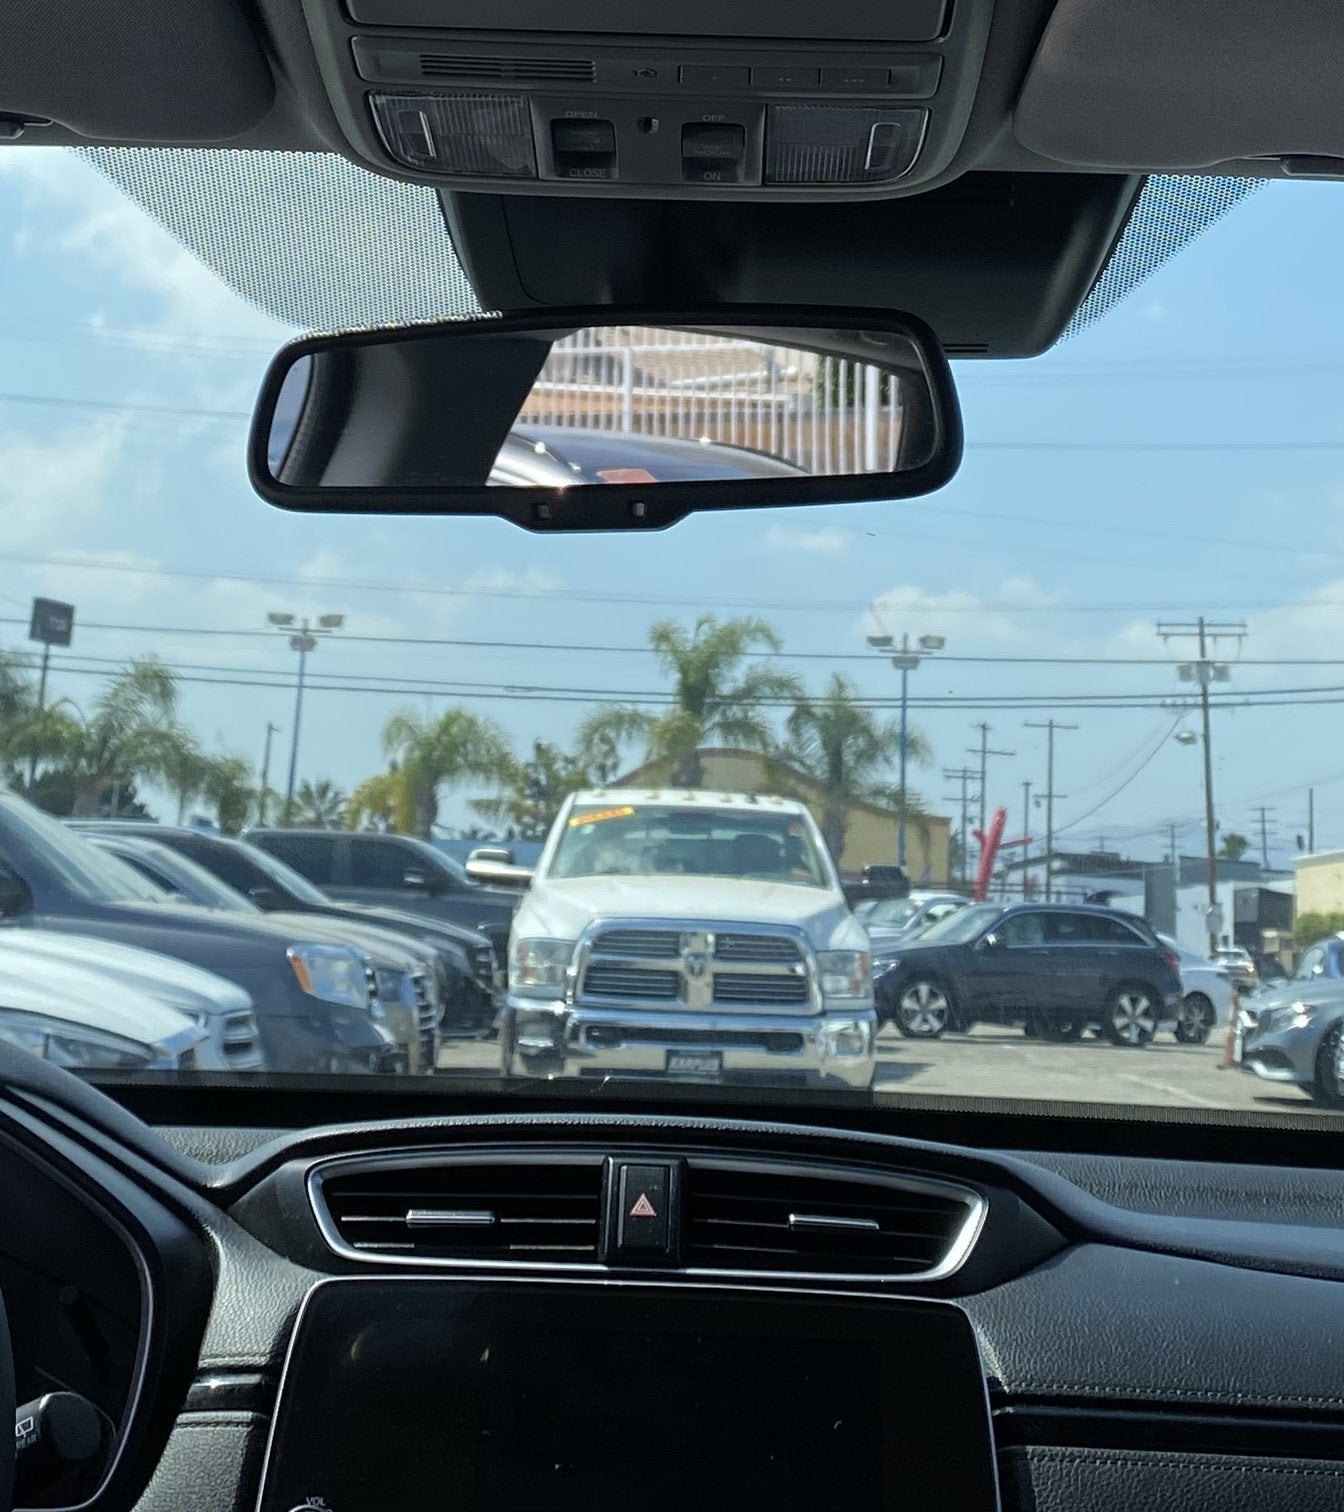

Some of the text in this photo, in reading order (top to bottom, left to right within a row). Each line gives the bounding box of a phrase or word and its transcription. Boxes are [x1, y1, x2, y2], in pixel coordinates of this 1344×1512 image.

[564, 110, 598, 119] OPEN
[702, 114, 726, 122] OFF
[569, 168, 608, 178] CLOSE
[703, 171, 722, 181] ON
[306, 1496, 326, 1507] VOL
